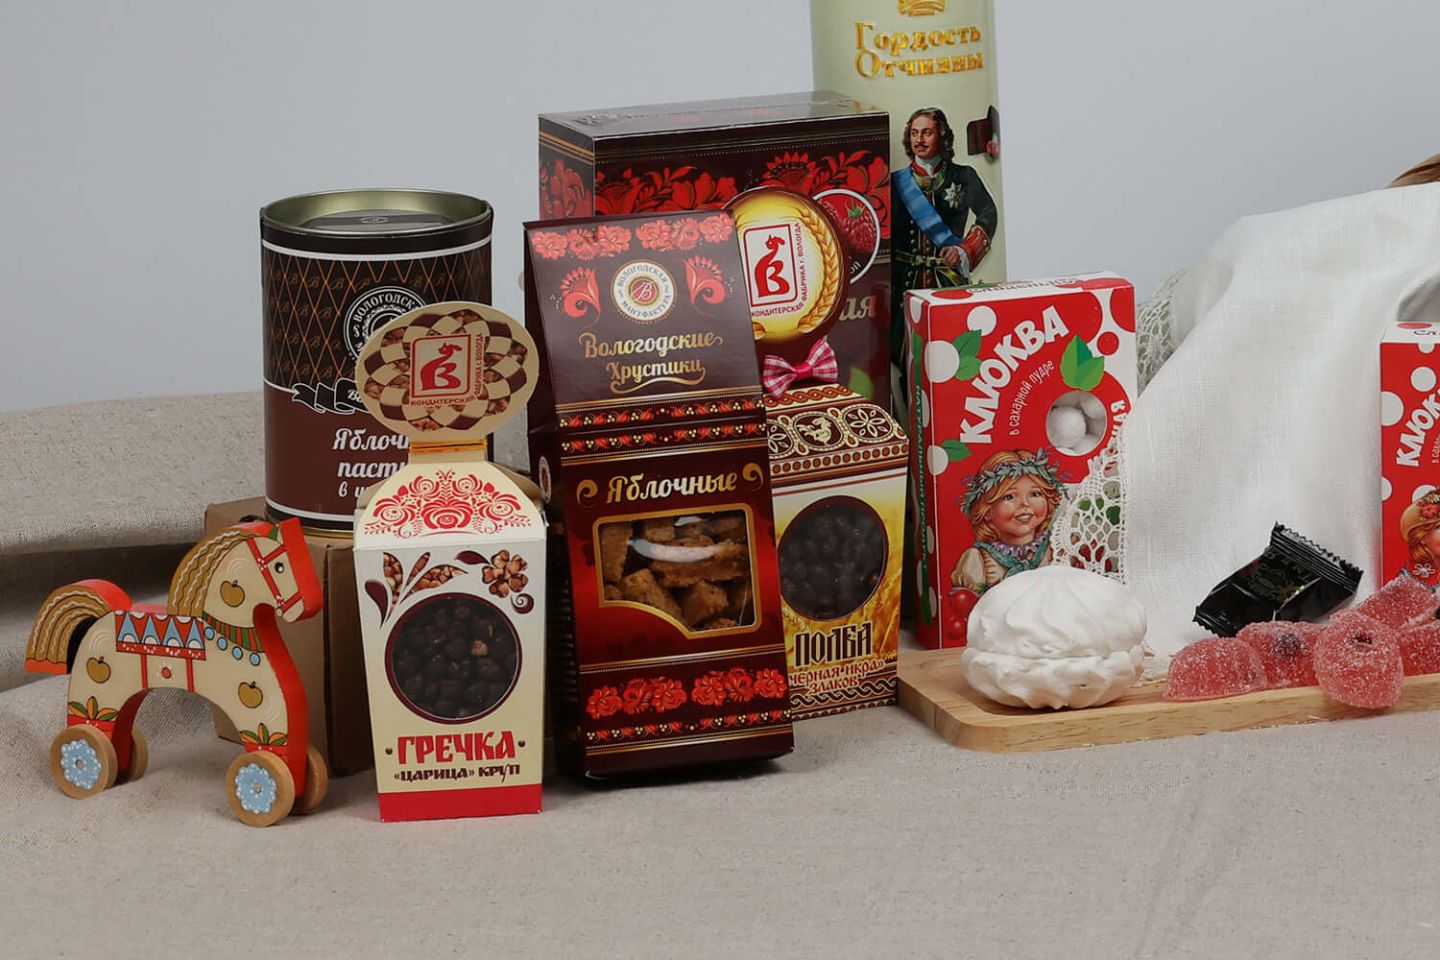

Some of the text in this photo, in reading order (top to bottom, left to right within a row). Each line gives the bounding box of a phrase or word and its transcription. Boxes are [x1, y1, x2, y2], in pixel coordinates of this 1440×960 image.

[854, 23, 984, 56] Гордость
[855, 48, 984, 79] Отчизны
[616, 264, 668, 288] ВОЛОГОДСКАЯ
[353, 292, 420, 323] ВОЛОГОДСК
[622, 294, 673, 319] МАНУФАКТУРА
[579, 332, 723, 358] Вологодские
[606, 359, 704, 385] Хрустики
[960, 305, 1070, 443] КЛЮКВА
[1009, 380, 1033, 427] сахарной
[1029, 360, 1055, 384] пудре
[606, 471, 738, 505] Яблочные
[795, 621, 873, 669] ПОЛБА
[397, 730, 516, 765] ГРЕЧКА
[394, 764, 521, 783] «ЦАРИЦА» КРУП
